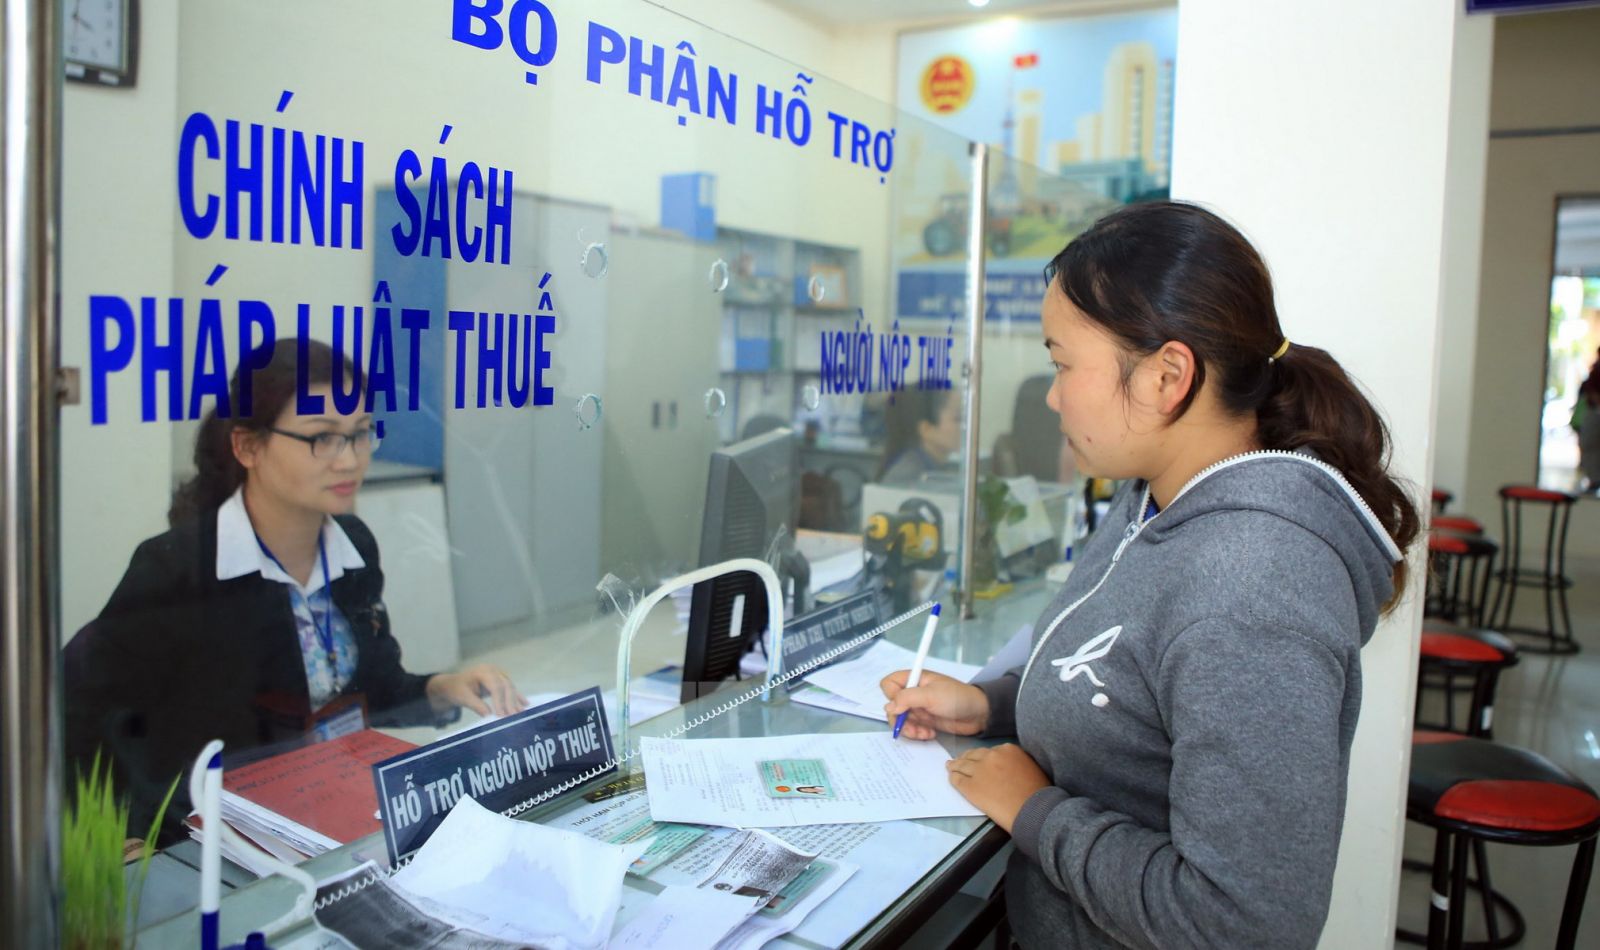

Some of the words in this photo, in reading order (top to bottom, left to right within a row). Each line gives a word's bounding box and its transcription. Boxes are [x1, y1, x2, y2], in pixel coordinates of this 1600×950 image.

[178, 90, 364, 250] CHÍNH
[391, 125, 514, 265] SÁCH
[586, 20, 738, 127] PHẬN
[756, 72, 814, 147] HỖ
[827, 110, 896, 184] TRỢ
[89, 264, 276, 425] PHÁP
[297, 281, 430, 439] LUẬT
[448, 273, 557, 409] THUẾ
[820, 308, 874, 395] NGƯỜI
[878, 320, 912, 407] NỘP
[918, 312, 957, 390] THUẾ
[391, 773, 423, 830] HỖ
[467, 746, 523, 798] NGƯỜI
[524, 734, 556, 778] NỘP
[558, 710, 601, 761] THUẾ
